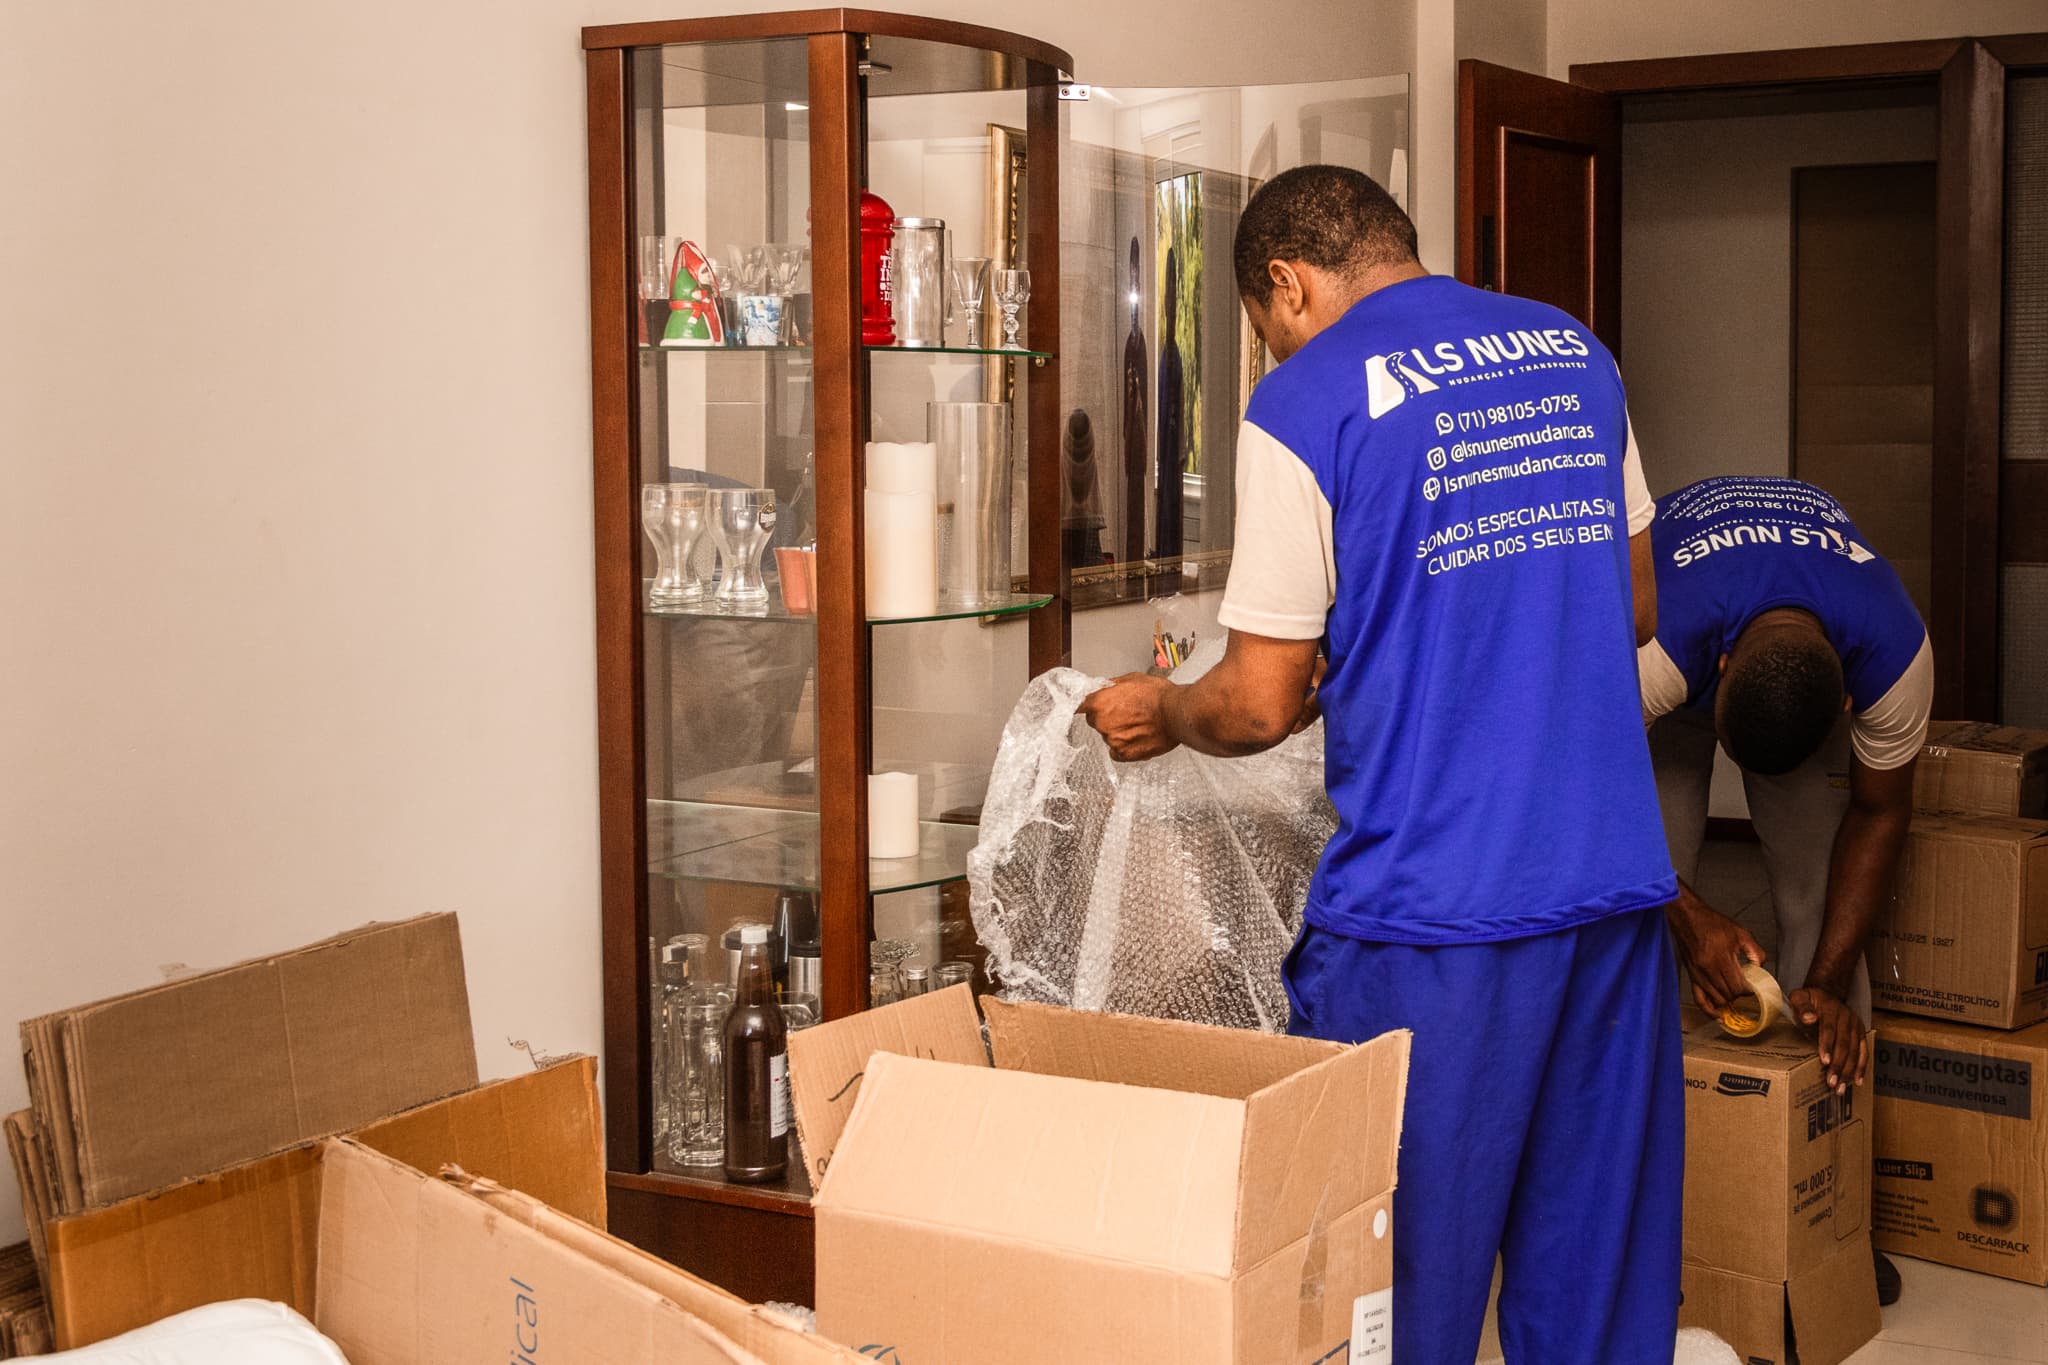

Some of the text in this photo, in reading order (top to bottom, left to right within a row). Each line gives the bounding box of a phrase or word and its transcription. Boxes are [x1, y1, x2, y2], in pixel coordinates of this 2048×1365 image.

[1411, 329, 1589, 375] LS NUNES
[1448, 370, 1504, 386] MUDANÇAS
[1519, 362, 1587, 373] TRANSPORTES
[1457, 394, 1581, 431] (71) 98105-0795
[1450, 424, 1595, 462] @lsnunesmudancas
[1444, 452, 1607, 494] lsnunesmudancas.com
[1696, 500, 1783, 521] 98105-0795
[1786, 501, 1815, 515] (71)
[1416, 523, 1474, 559] SOMOS
[1477, 498, 1606, 534] ESPECIALISTAS
[1673, 525, 1829, 568] LS NUNES
[1427, 523, 1615, 575] CUIDAR DOS SEUS BEN
[1871, 981, 2000, 1008] ENTRADO POLIELETROLÍTICO
[1880, 992, 1903, 1005] PARA
[1899, 1047, 2029, 1086] Macrogotas
[1875, 1073, 2008, 1106] nfusão intravenosa
[1793, 1165, 1832, 1200] 5.000 mL
[1877, 1160, 1927, 1178] Luer Slip
[1957, 1230, 2031, 1254] DESCARPACK
[508, 1276, 538, 1365] ical
